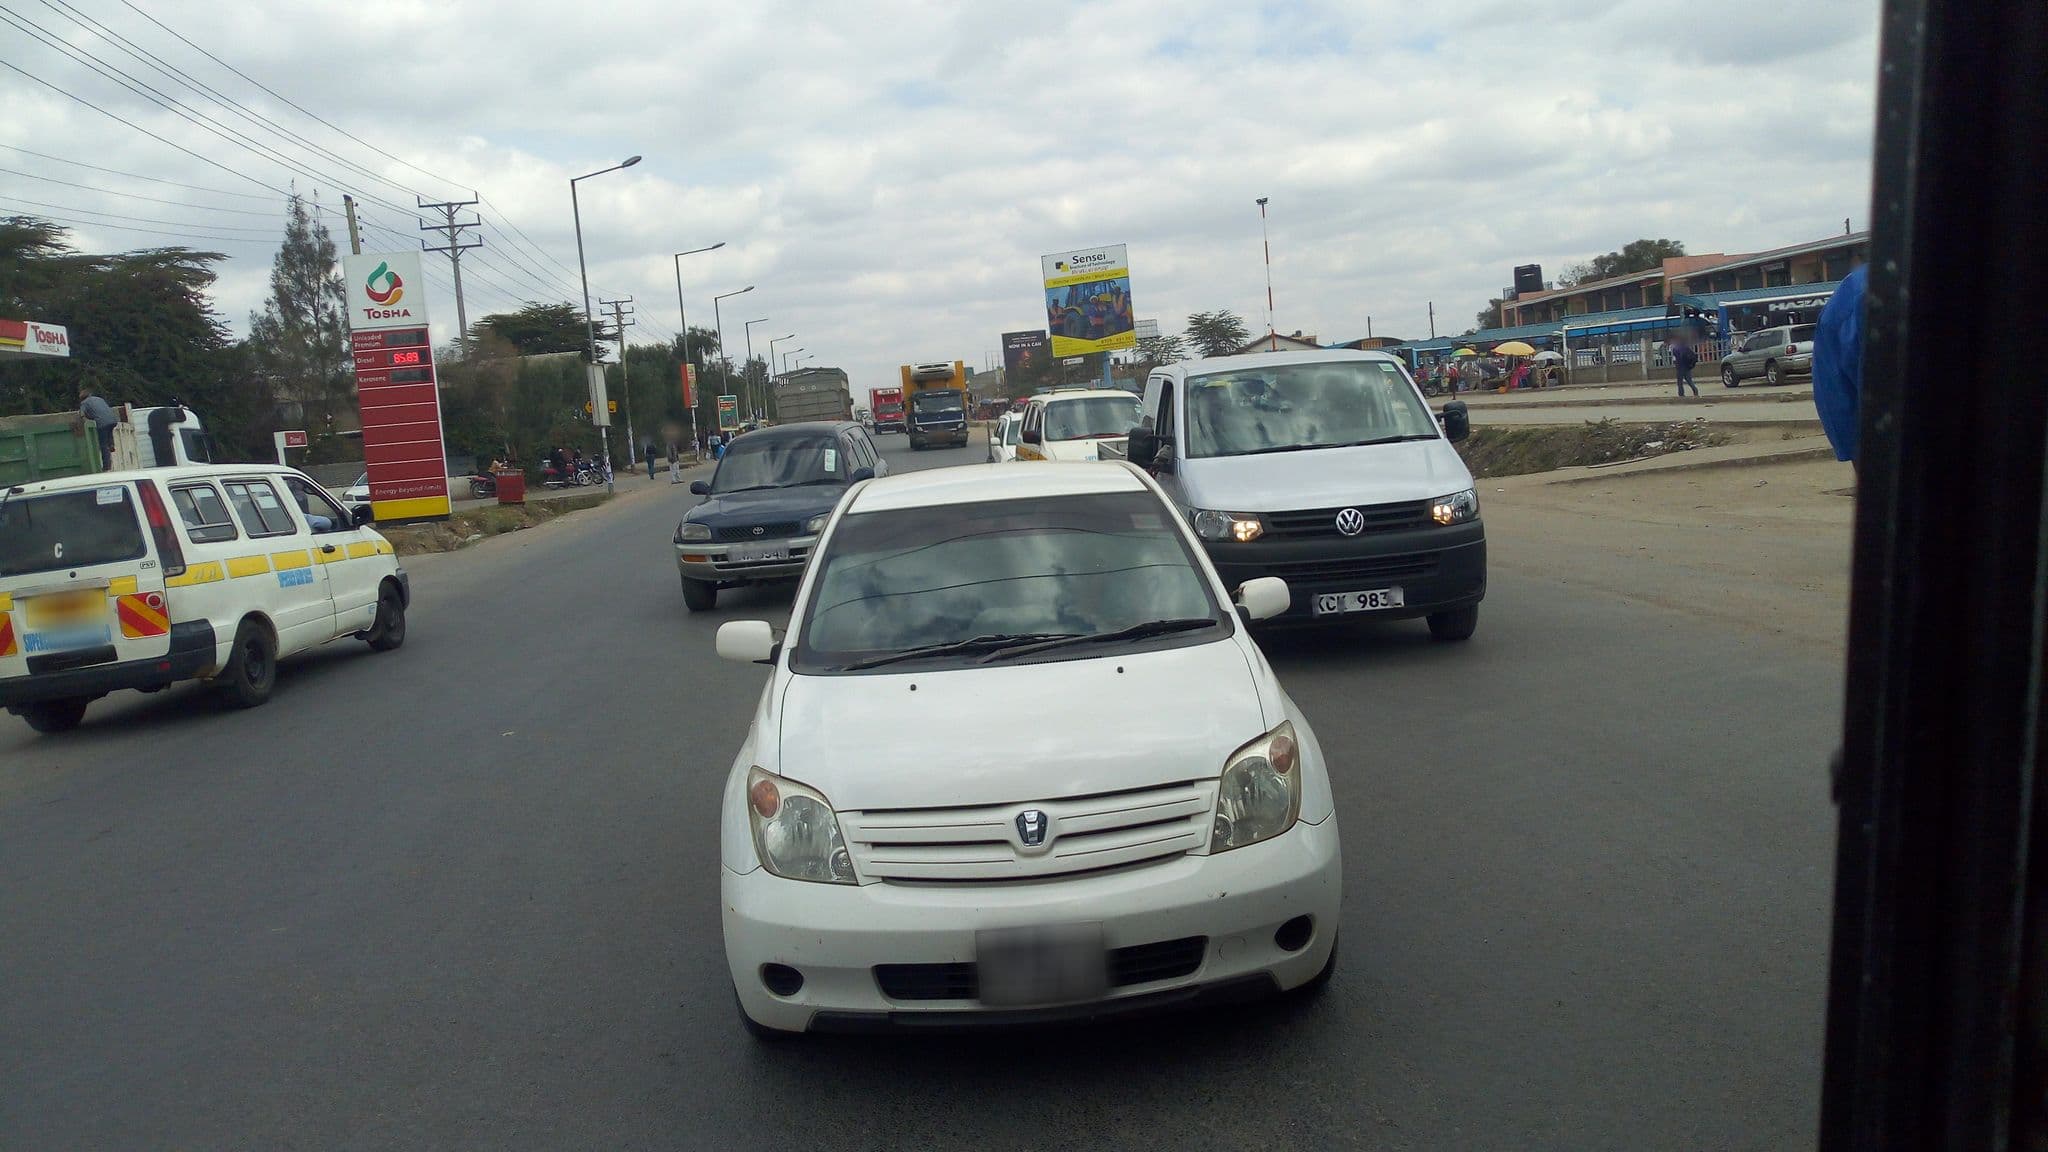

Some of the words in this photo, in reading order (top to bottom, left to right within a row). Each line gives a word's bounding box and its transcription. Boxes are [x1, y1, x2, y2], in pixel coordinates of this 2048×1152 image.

[1072, 253, 1107, 265] Sensei
[363, 307, 411, 320] TOSHA
[31, 325, 66, 346] TOSHA
[354, 334, 382, 342] Unleaded
[356, 356, 375, 364] Diesel
[54, 542, 63, 559] C
